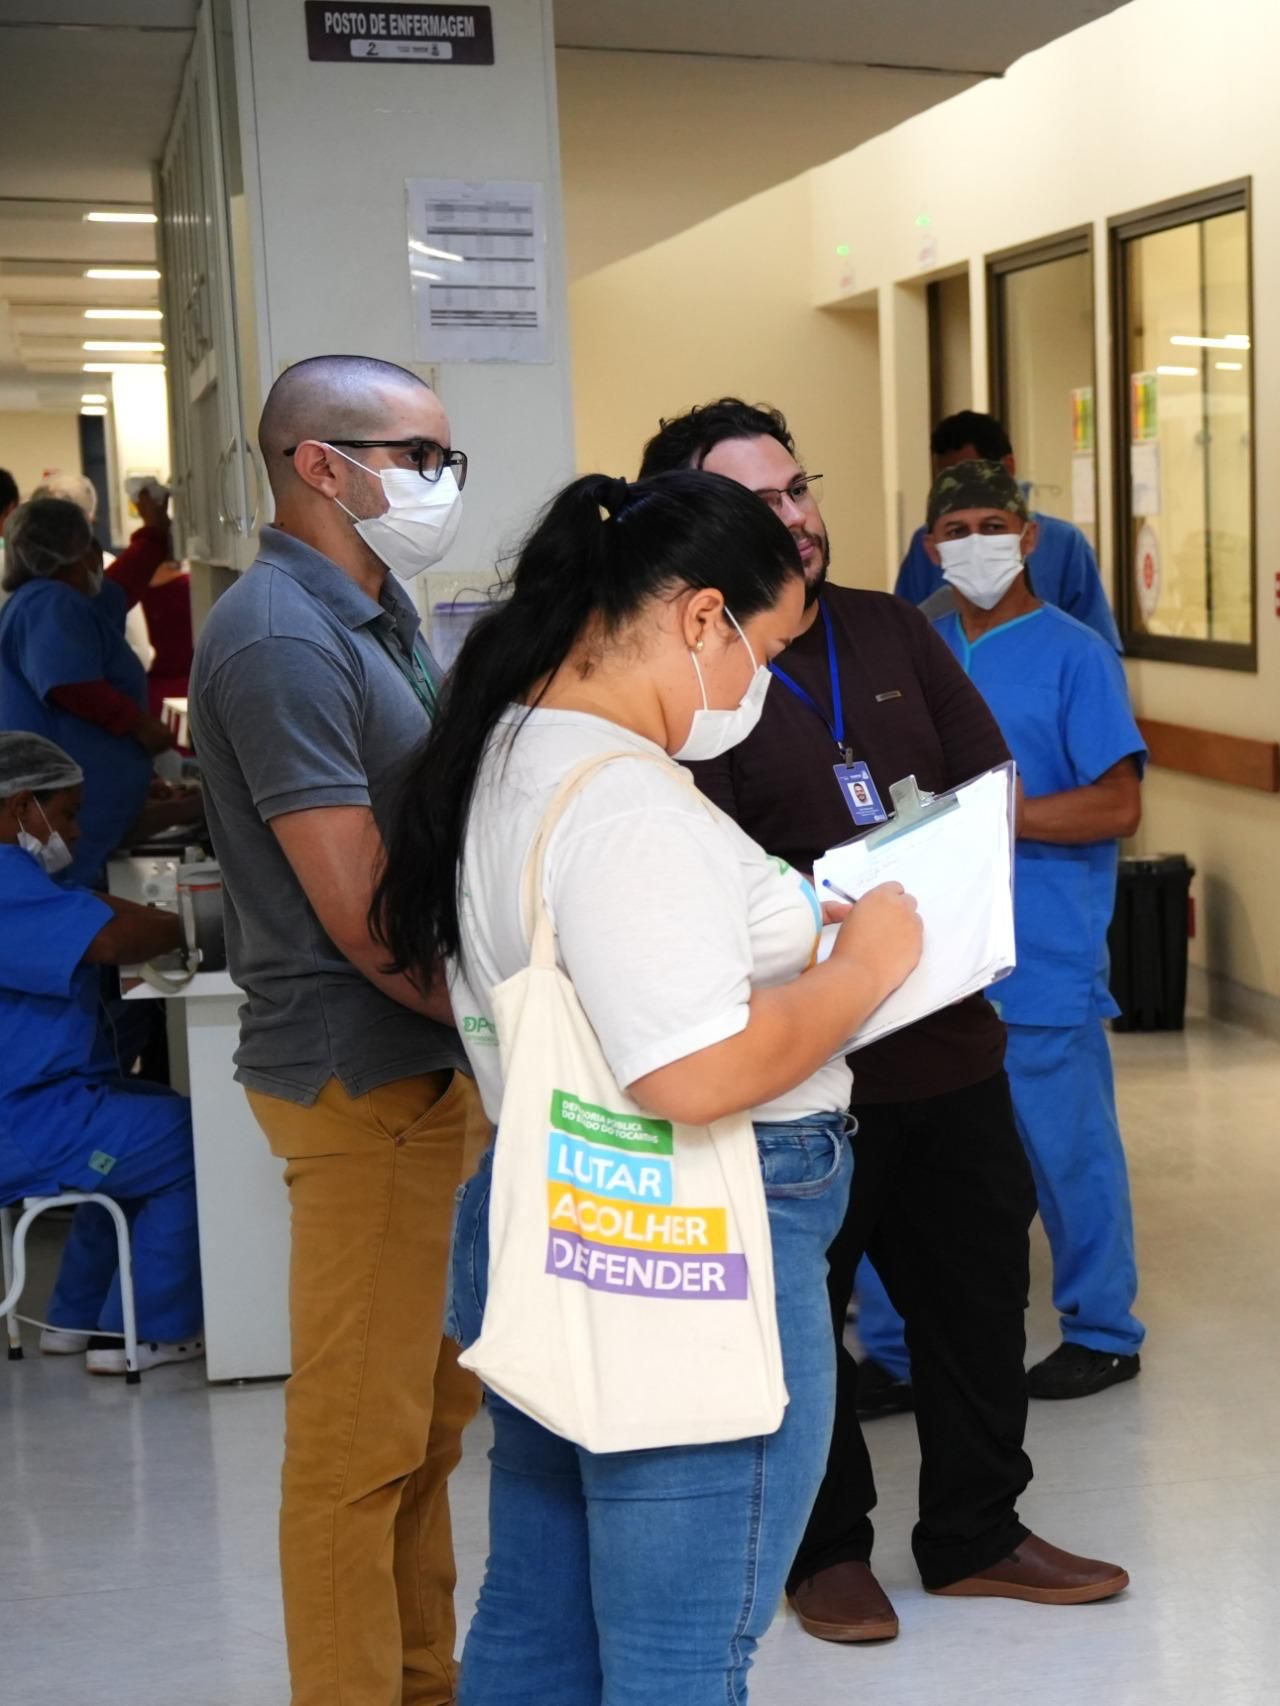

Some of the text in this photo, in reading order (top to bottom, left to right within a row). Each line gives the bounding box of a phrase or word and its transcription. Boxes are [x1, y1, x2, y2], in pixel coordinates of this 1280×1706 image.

[324, 12, 475, 37] POSTO DE ENFERMAGEM
[561, 1109, 575, 1120] DO
[557, 1144, 662, 1198] LUTAR
[552, 1193, 708, 1246] ACOLHER
[552, 1237, 726, 1292] DEFENDER
